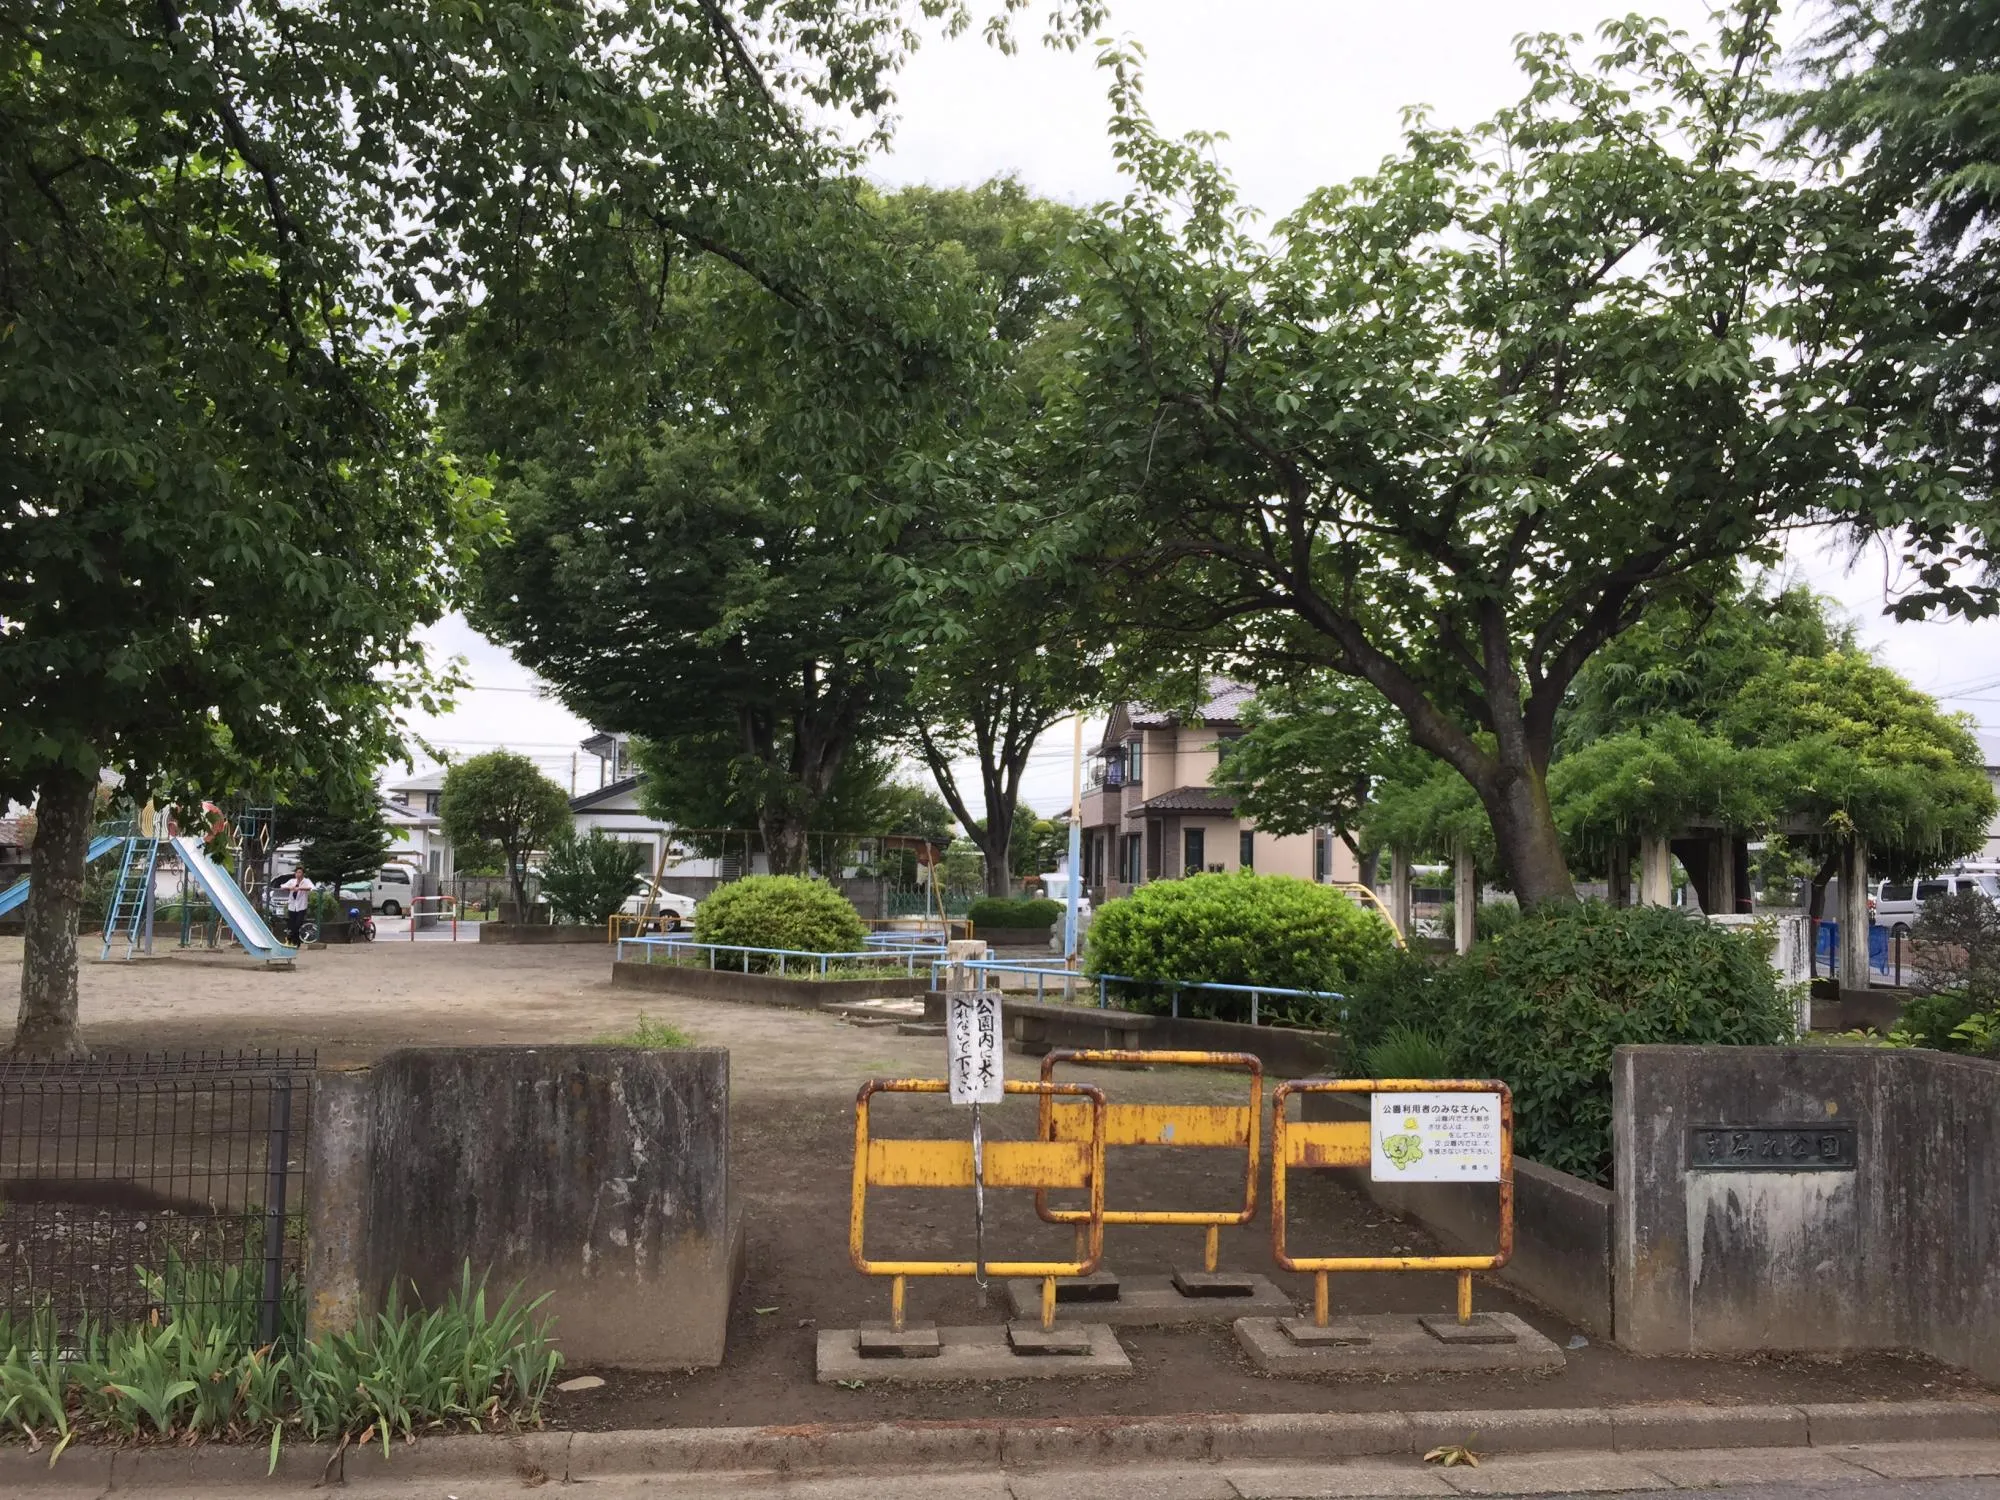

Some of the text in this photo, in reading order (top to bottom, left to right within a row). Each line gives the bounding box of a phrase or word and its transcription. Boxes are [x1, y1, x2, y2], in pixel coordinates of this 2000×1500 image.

[953, 998, 972, 1094] 入れないで下さい
[976, 998, 995, 1088] 公園内に犬を
[1383, 1104, 1489, 1114] 公園利用者のみなさんへ
